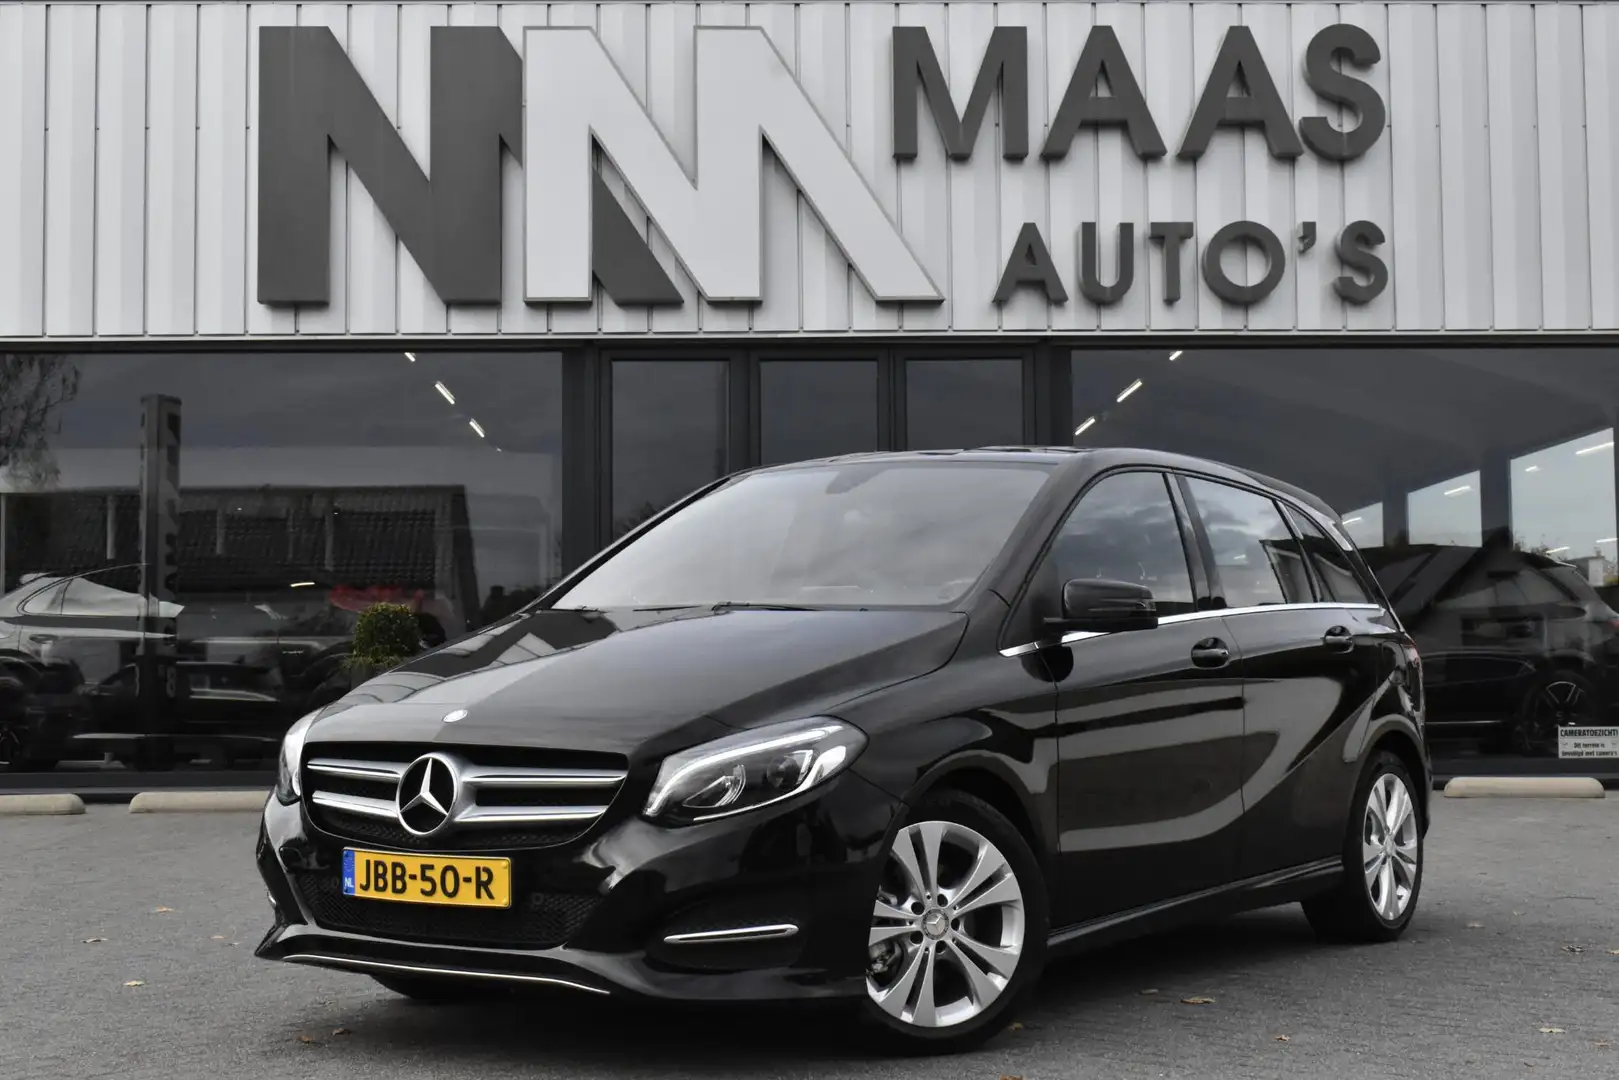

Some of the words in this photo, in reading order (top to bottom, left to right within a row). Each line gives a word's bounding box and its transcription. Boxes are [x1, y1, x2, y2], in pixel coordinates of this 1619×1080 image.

[891, 23, 1387, 161] MAAS
[992, 219, 1389, 304] AUTO'S
[344, 876, 354, 889] NL
[359, 859, 495, 900] JBB-50-R
